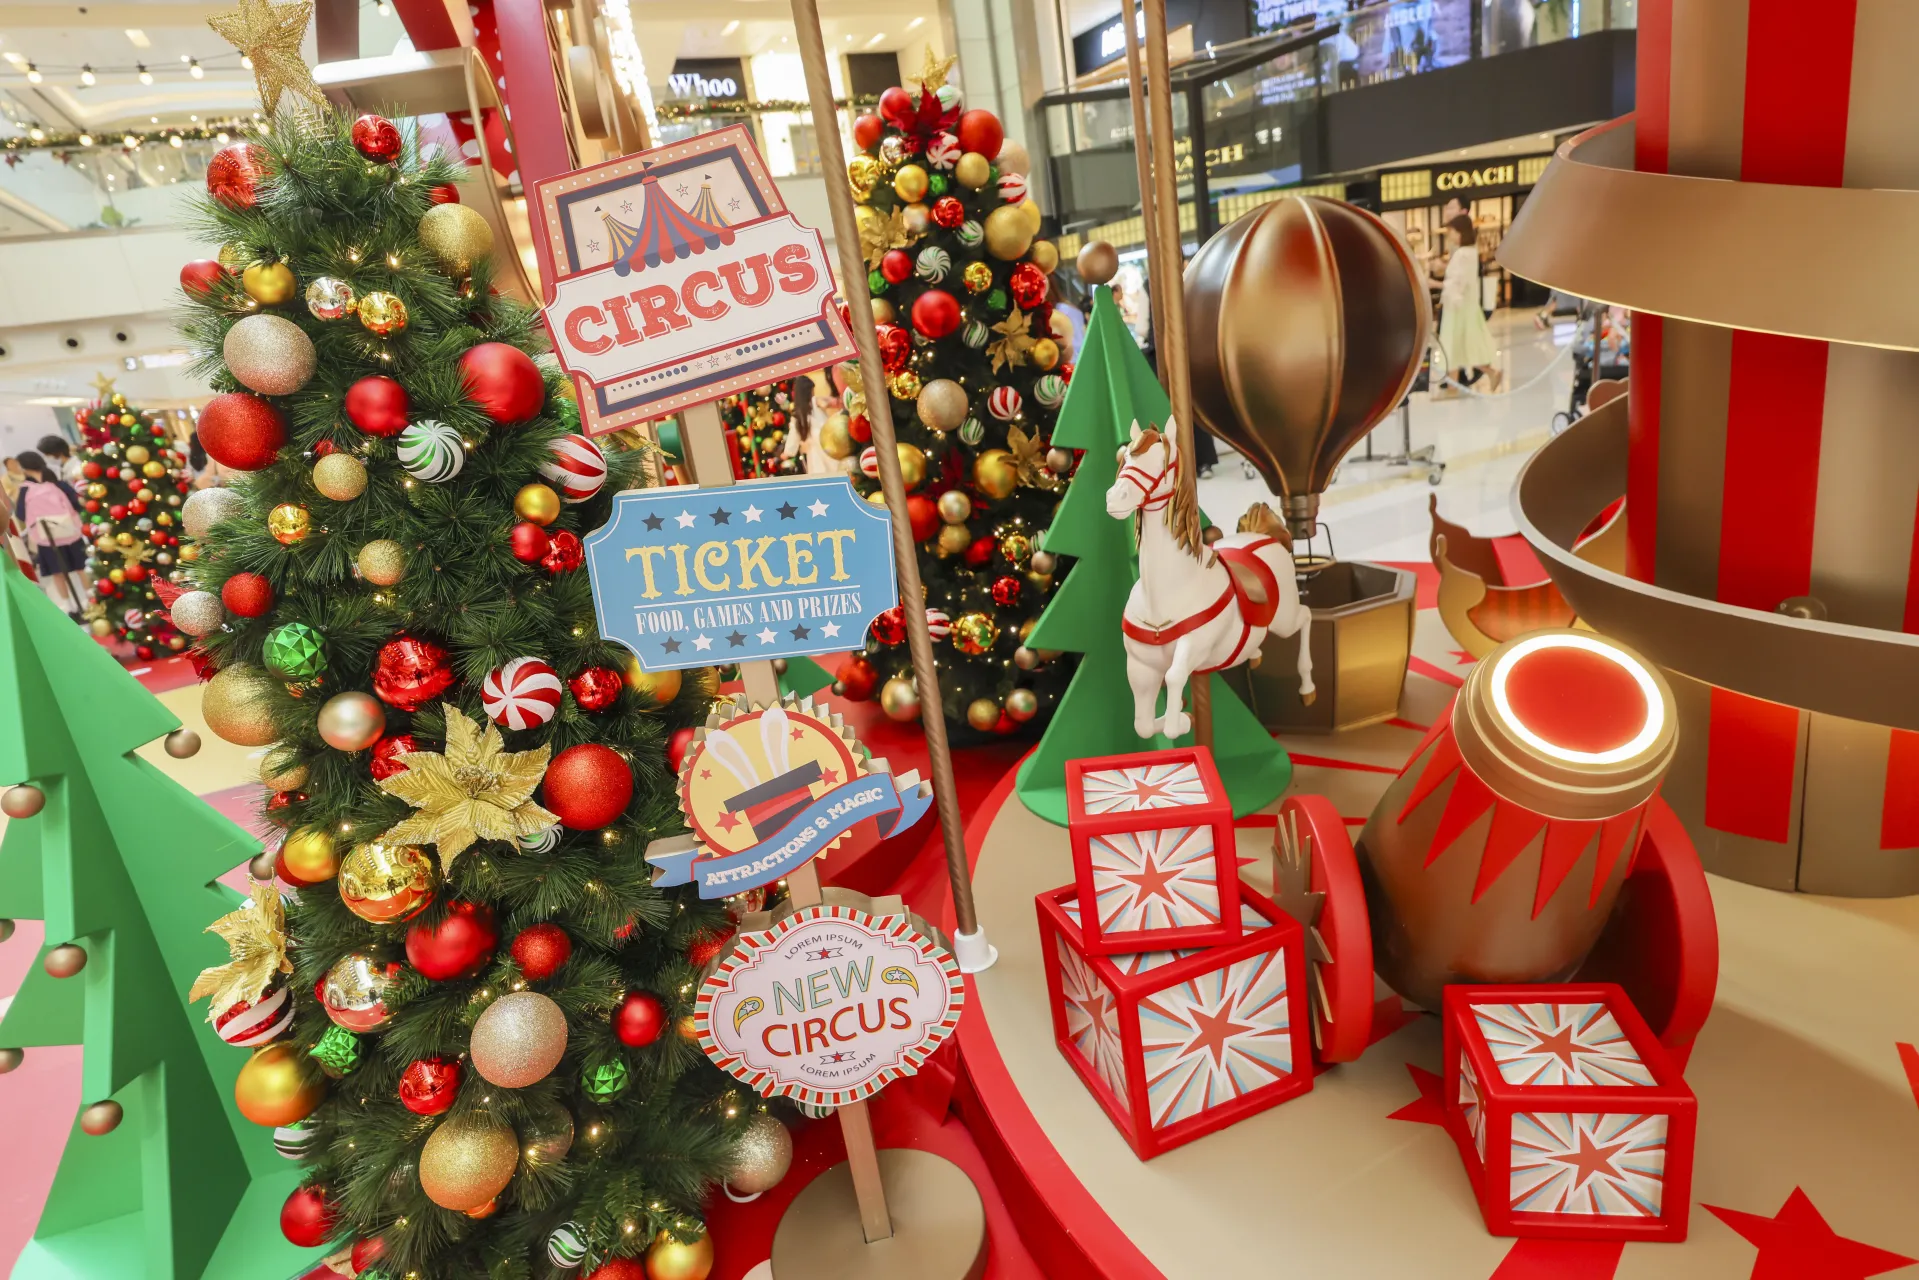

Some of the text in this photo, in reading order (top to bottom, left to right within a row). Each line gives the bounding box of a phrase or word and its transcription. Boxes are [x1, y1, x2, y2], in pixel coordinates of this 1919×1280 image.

[668, 73, 737, 98] Whoo
[1436, 165, 1514, 191] COACH
[564, 243, 818, 356] CIRCUS
[624, 528, 856, 600] TICKET
[635, 592, 862, 635] FOOD, GAMES AND PRIZES
[705, 787, 884, 886] ATTRACTIONS & MAGIC
[784, 933, 863, 960] LOREM IPSUM
[772, 955, 875, 1016] NEW
[761, 997, 913, 1058] CIRCUS
[799, 1052, 877, 1078] LOREM IPSUM
